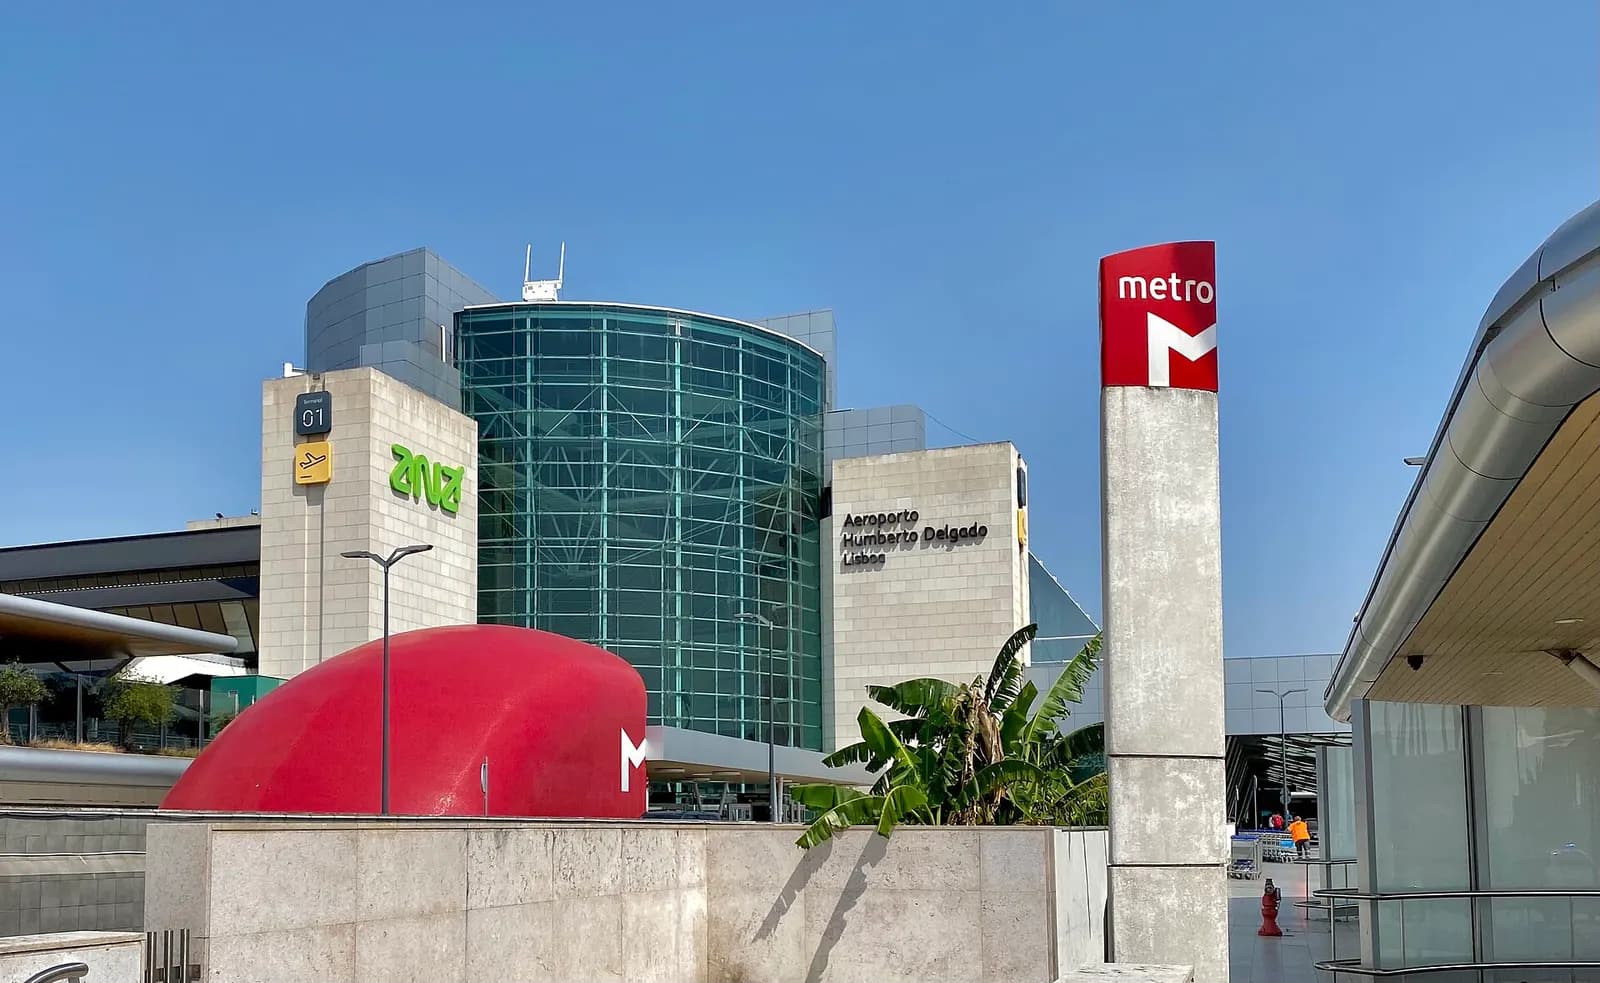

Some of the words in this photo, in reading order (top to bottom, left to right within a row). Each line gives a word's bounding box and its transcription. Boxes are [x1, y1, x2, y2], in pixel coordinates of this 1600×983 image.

[1119, 273, 1213, 303] metro
[1147, 312, 1217, 387] M
[303, 408, 323, 427] 01
[390, 444, 464, 513] ana
[843, 509, 919, 528] Aeroporto
[843, 529, 918, 548] Humberto
[924, 522, 988, 543] Delgado
[843, 552, 886, 566] Lisboa
[620, 727, 646, 792] M
